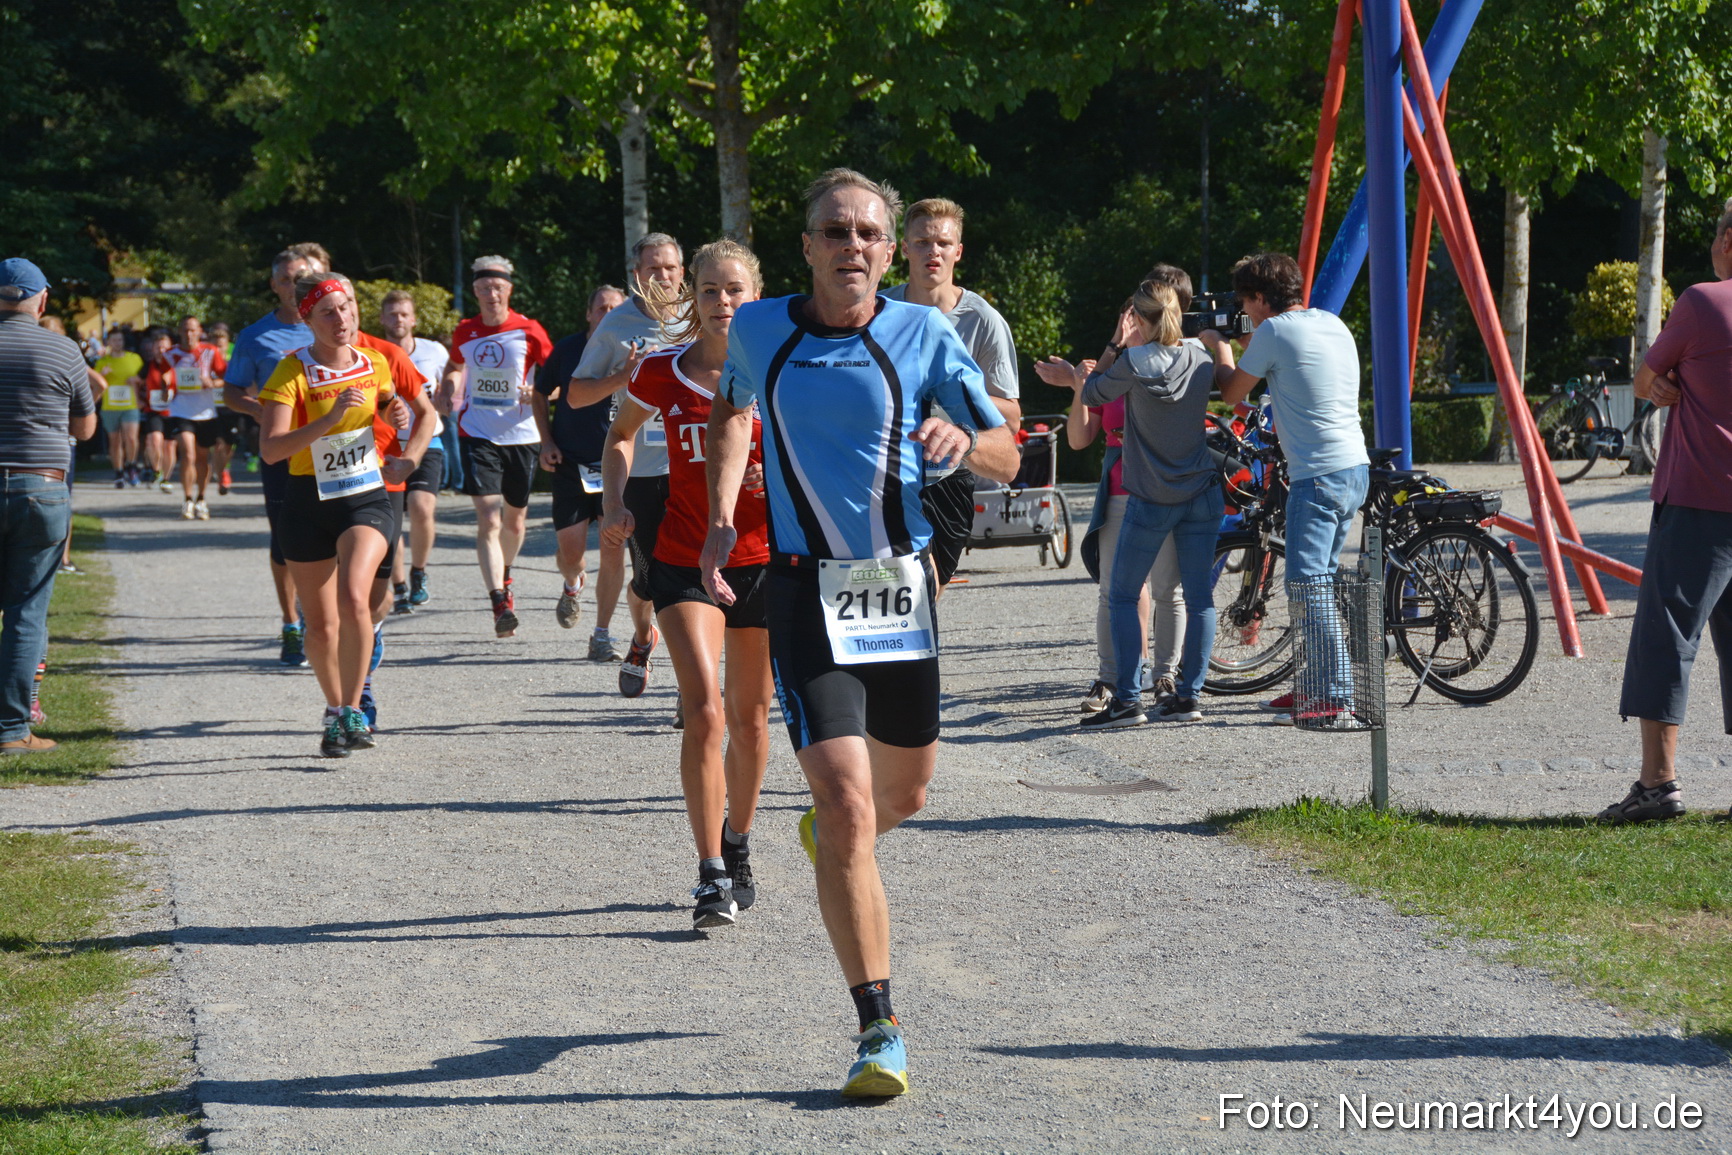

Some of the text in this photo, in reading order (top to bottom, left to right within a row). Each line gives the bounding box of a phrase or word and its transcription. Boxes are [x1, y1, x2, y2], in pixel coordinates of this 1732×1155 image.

[310, 379, 376, 402] MAX ÖGL
[477, 379, 509, 393] 2603
[323, 445, 366, 472] 2417
[338, 477, 364, 489] Marina
[852, 568, 899, 581] BOCK
[836, 587, 912, 620] 2116
[845, 622, 898, 632] PARTL Neumarkt
[854, 638, 904, 652] Thomas
